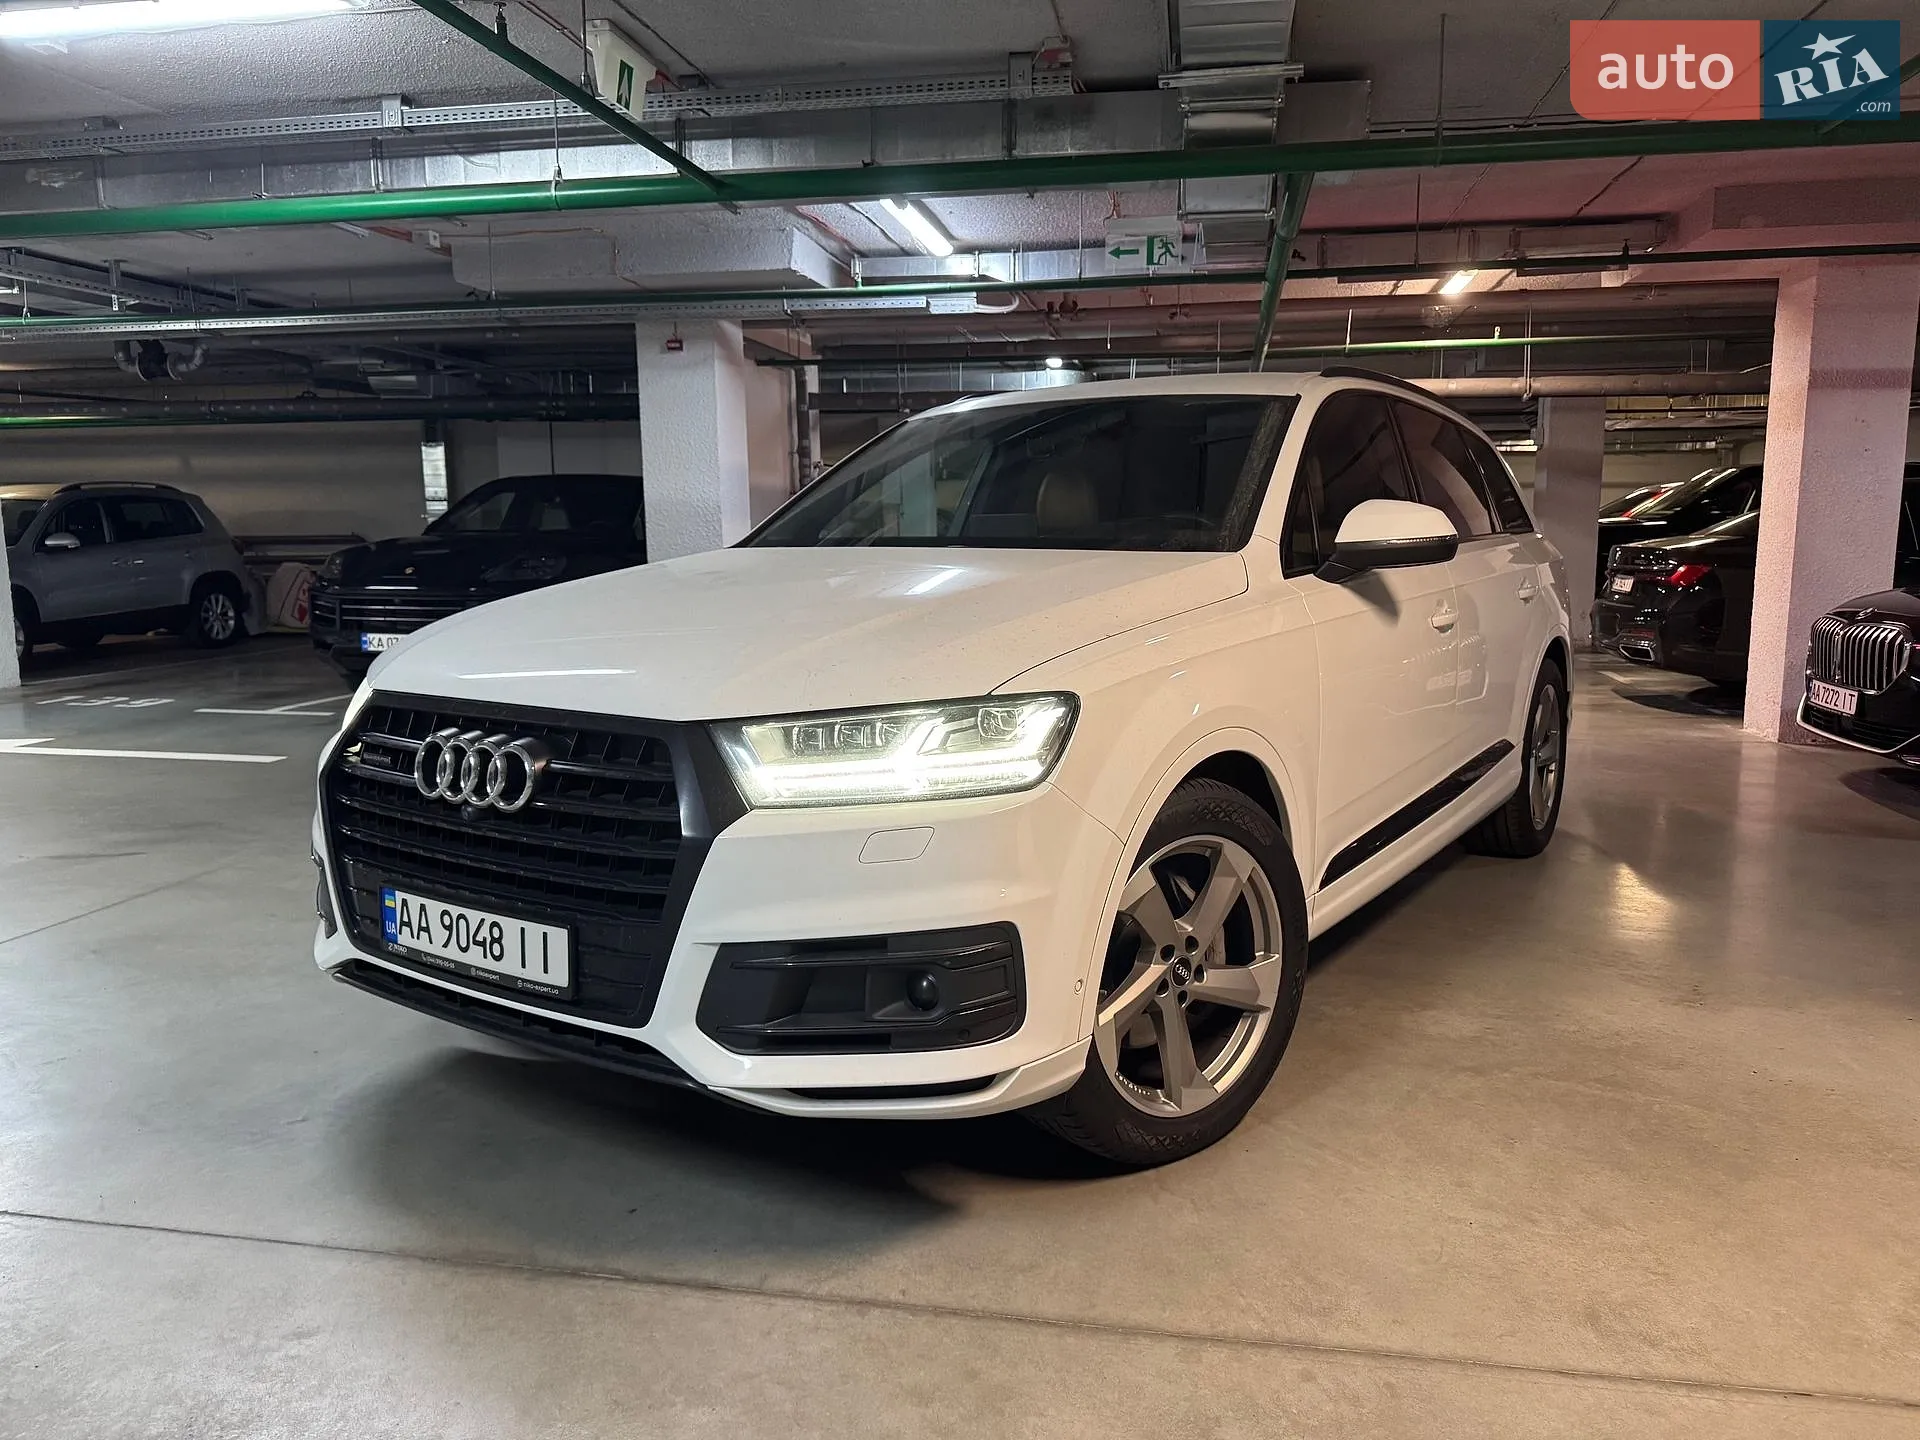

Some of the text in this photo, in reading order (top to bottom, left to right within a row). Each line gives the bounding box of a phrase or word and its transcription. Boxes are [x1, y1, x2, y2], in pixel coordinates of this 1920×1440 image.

[368, 637, 384, 649] KA
[1812, 683, 1856, 711] AA 7272 IT
[386, 920, 396, 934] UA
[399, 898, 433, 945] AA
[440, 909, 504, 962] 9048
